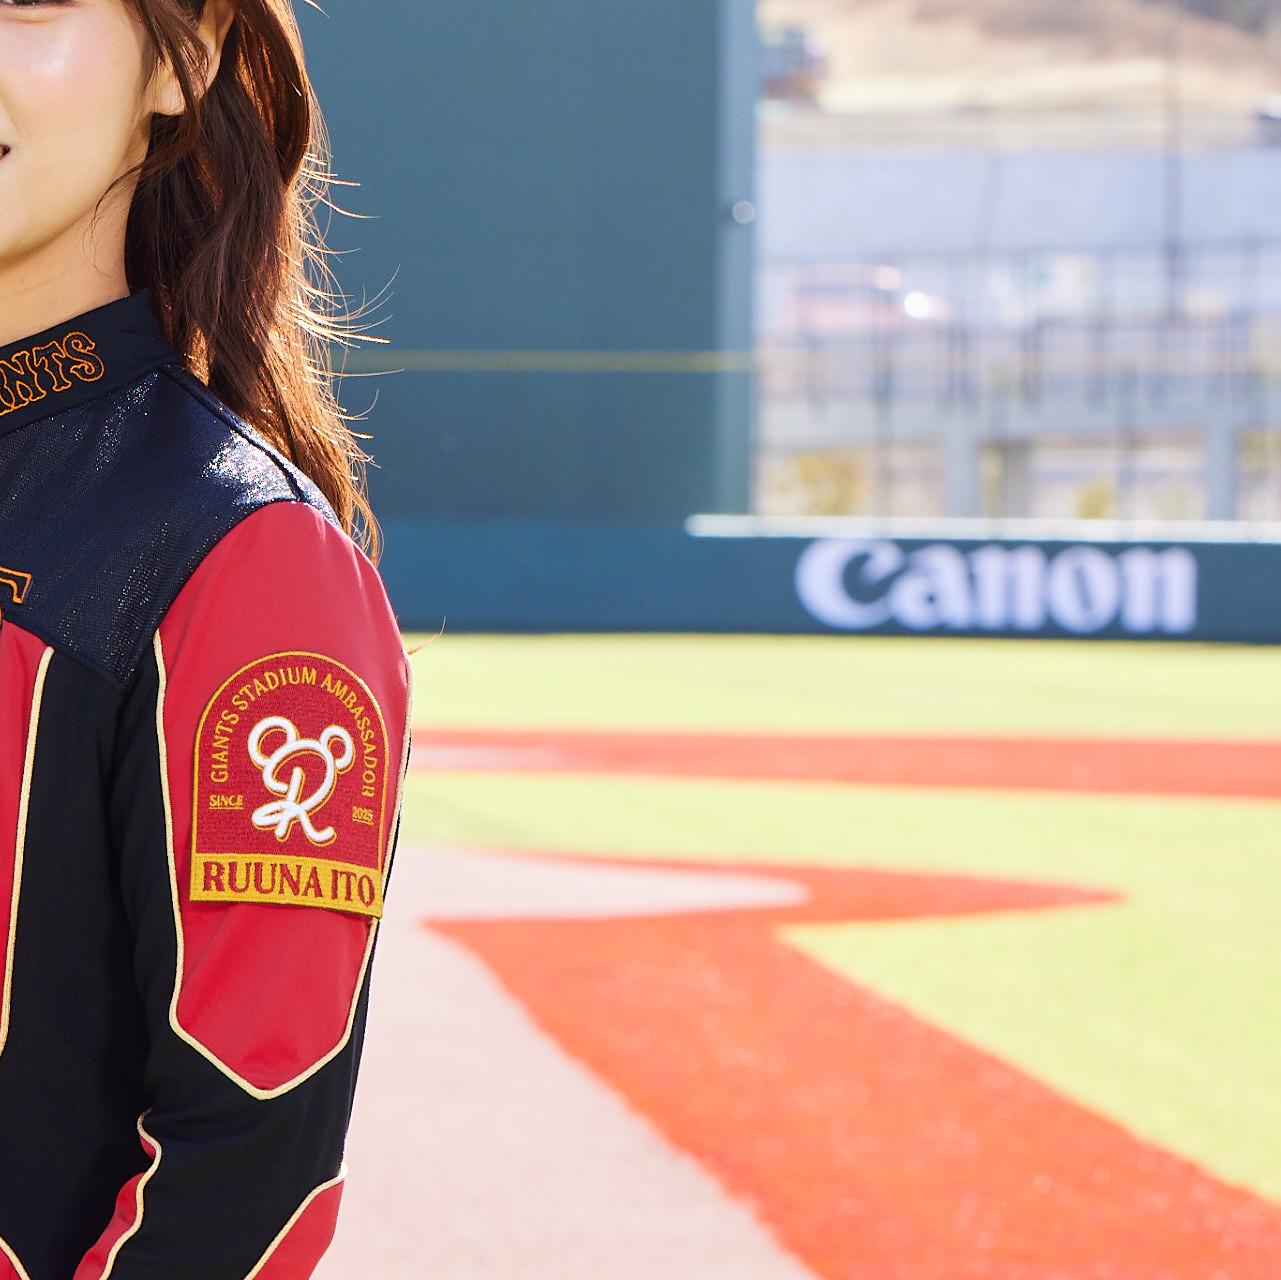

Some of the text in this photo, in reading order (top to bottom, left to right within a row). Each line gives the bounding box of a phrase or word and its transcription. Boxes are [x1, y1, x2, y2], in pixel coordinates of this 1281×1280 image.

[795, 537, 1198, 634] Canon
[210, 666, 379, 798] GIANTS STADIUM AMBASSADOR
[209, 794, 243, 808] SINCE
[352, 806, 374, 822] 2025
[202, 861, 375, 908] RUUNA ITO
